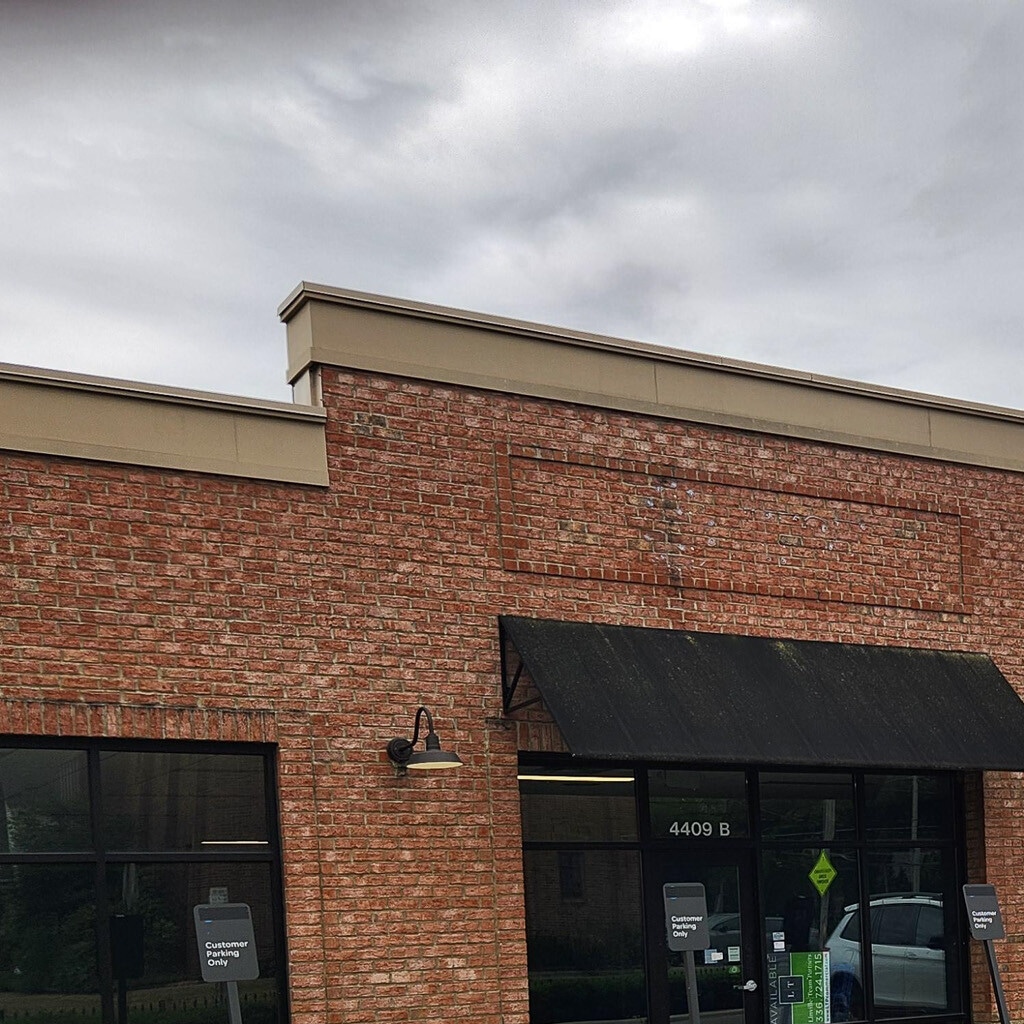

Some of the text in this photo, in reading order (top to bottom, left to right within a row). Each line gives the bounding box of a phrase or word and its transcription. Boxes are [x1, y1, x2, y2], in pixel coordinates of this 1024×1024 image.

[669, 821, 730, 836] 4409 B
[672, 922, 697, 931] Parking
[672, 930, 688, 938] Only
[205, 941, 249, 949] Customer
[206, 949, 240, 958] Parking
[207, 958, 228, 967] Only
[814, 953, 824, 1023] 336.724.1715
